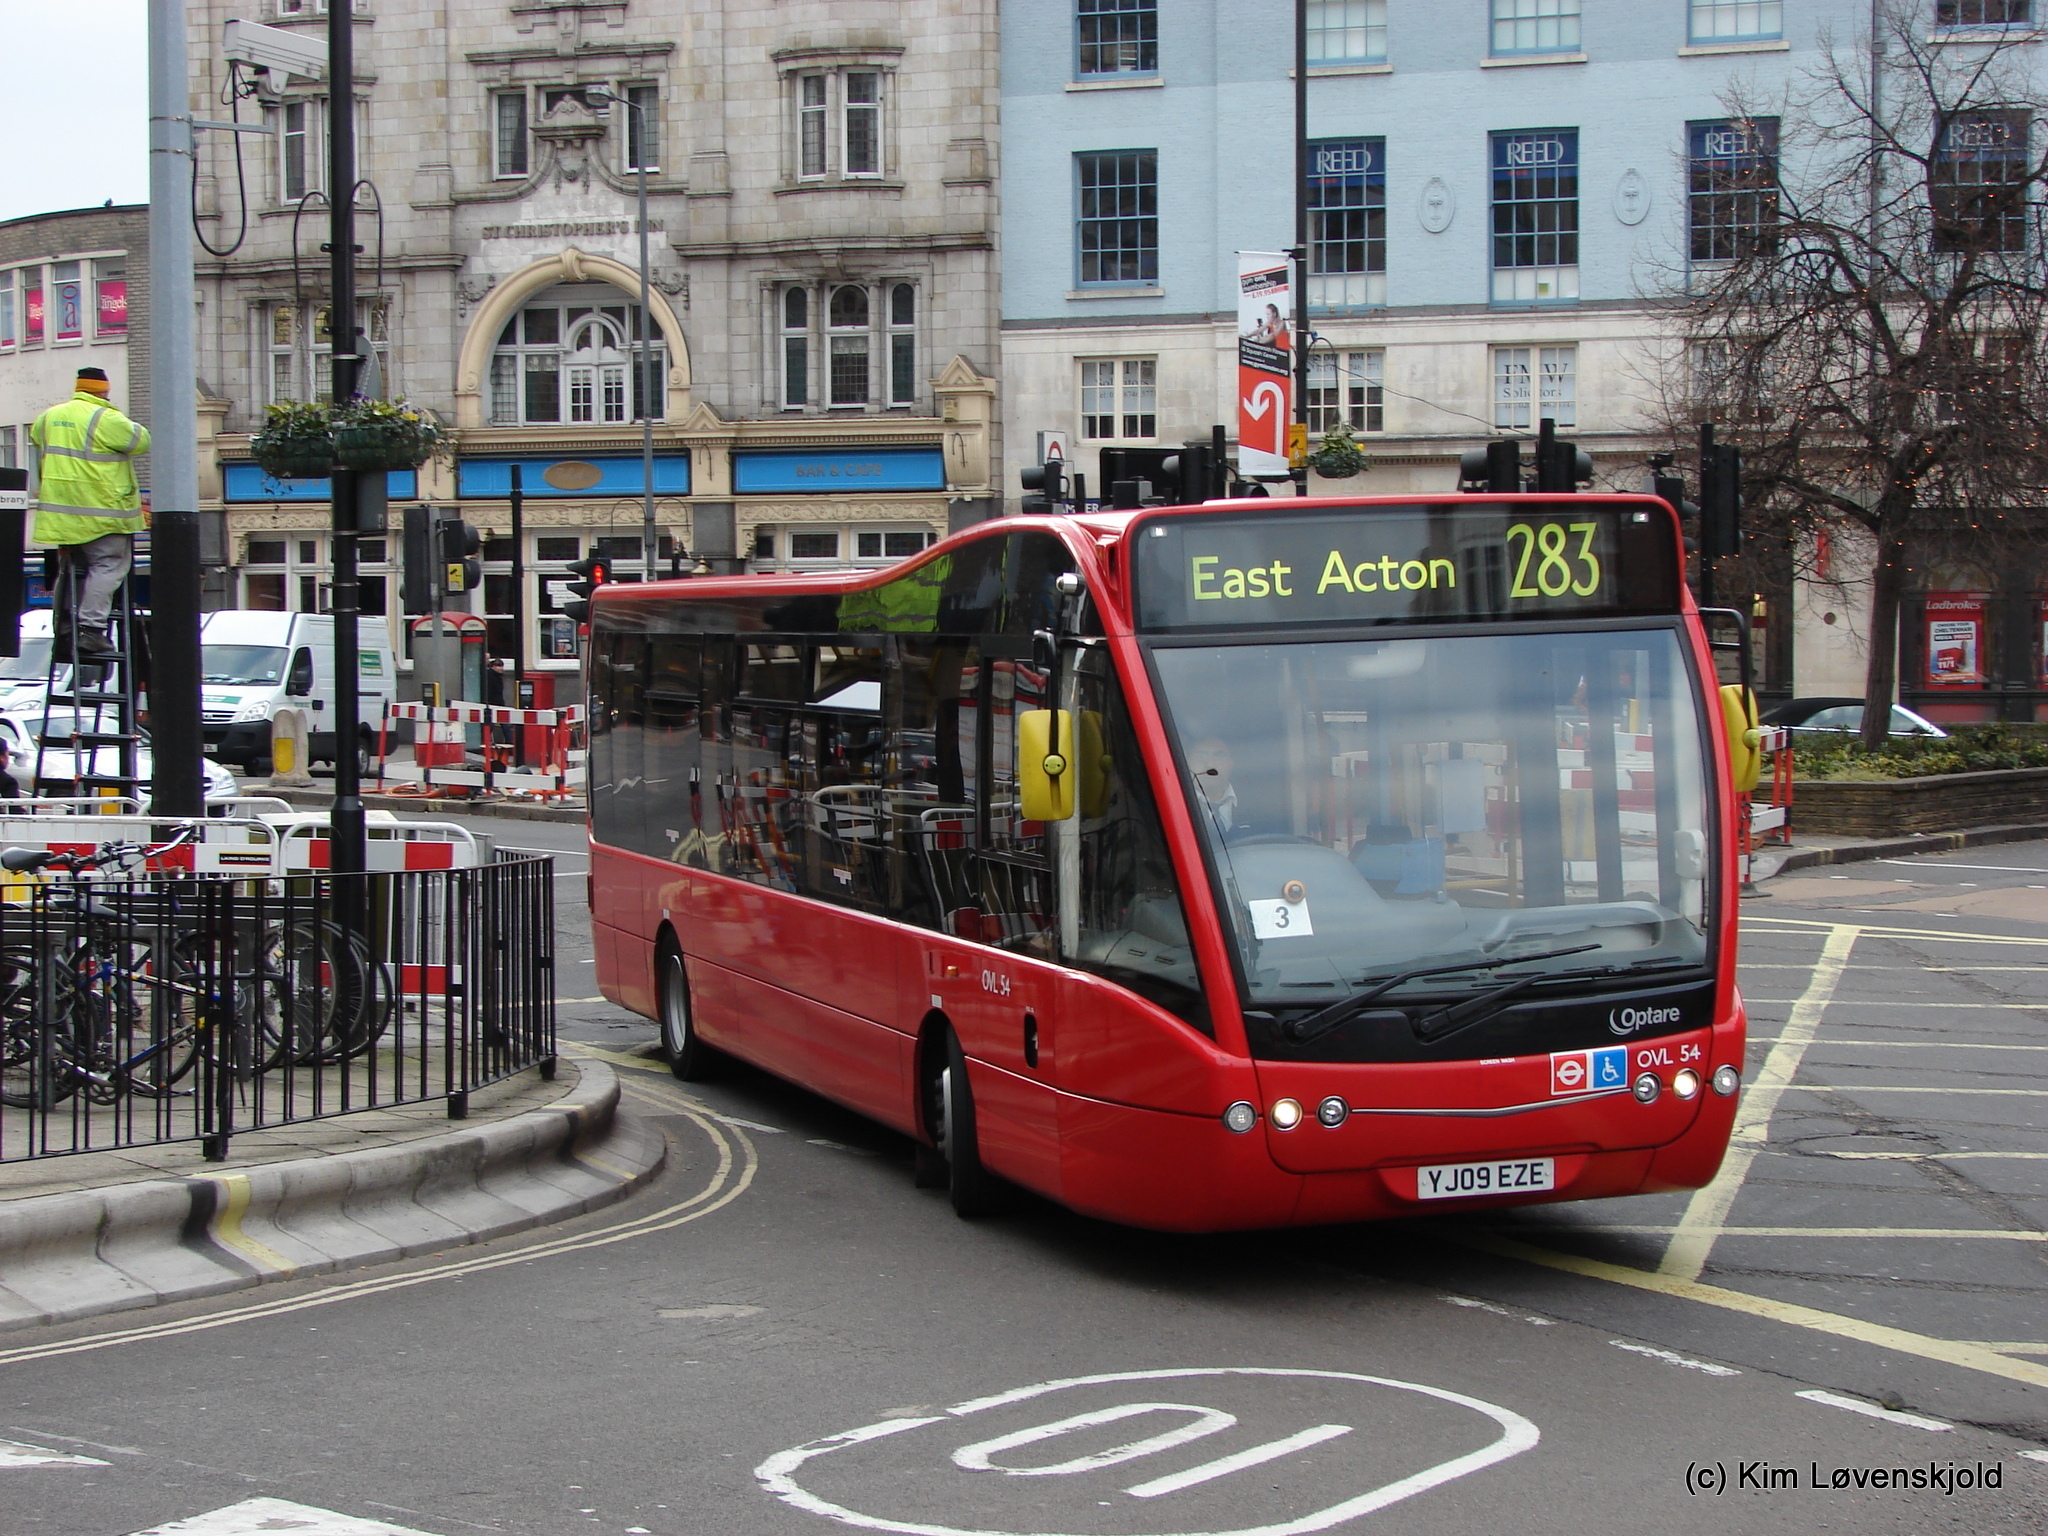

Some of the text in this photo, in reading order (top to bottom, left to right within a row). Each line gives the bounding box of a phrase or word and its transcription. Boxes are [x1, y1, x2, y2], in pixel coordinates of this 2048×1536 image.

[1316, 149, 1372, 173] REED
[1506, 140, 1564, 165] REED
[504, 220, 630, 238] CHRISTOPHER'S
[633, 219, 664, 234] IN
[1503, 386, 1562, 399] Solictors
[795, 464, 826, 478] BAR
[829, 463, 840, 477] &
[1191, 521, 1600, 601] East Acton 283
[1926, 600, 1981, 610] Ladbrokes
[1275, 905, 1290, 929] 3
[982, 969, 1011, 998] OVL 54
[1621, 1006, 1680, 1031] Optare
[1637, 1044, 1701, 1068] OVL 54
[1428, 1162, 1544, 1193] YJ09 EZE
